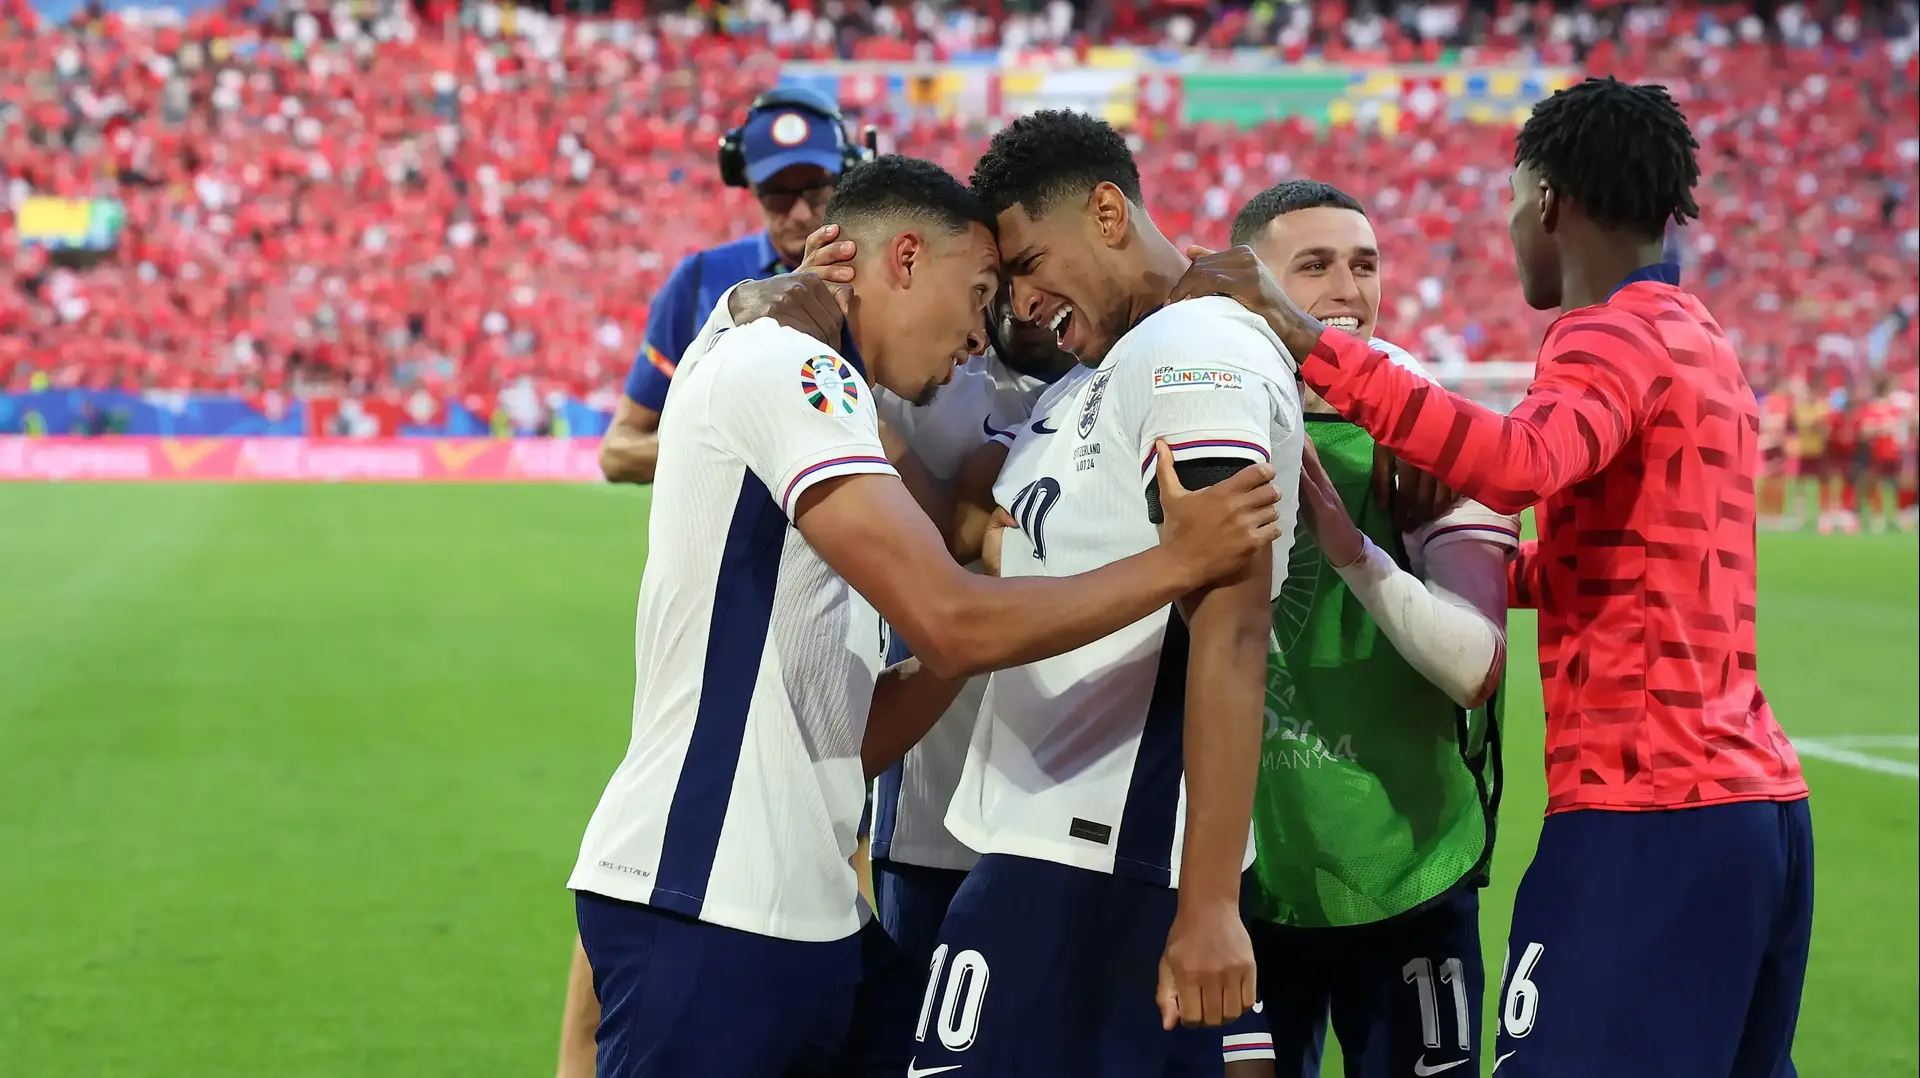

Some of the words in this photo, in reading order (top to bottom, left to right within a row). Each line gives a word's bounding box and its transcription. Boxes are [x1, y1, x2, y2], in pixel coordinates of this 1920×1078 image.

[1154, 366, 1174, 375] UEFA
[1154, 371, 1242, 386] FOUNDATION
[1262, 749, 1325, 770] MANY
[915, 943, 990, 1052] 10
[1402, 957, 1470, 1051] 11
[1496, 941, 1545, 1039] 6
